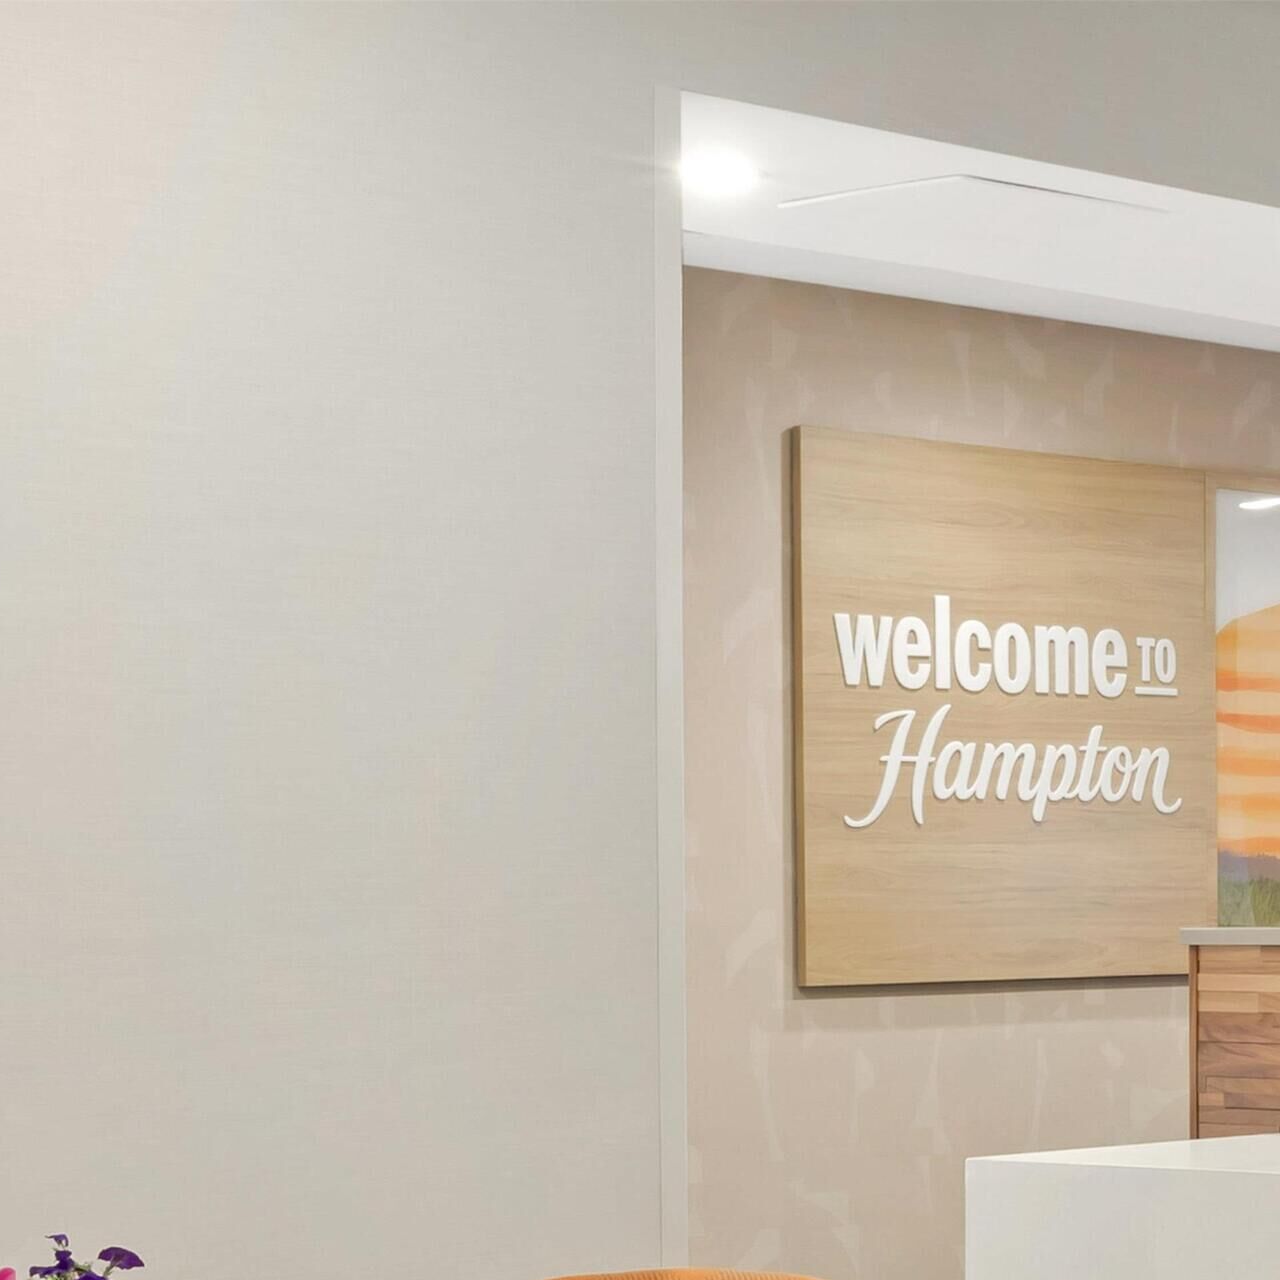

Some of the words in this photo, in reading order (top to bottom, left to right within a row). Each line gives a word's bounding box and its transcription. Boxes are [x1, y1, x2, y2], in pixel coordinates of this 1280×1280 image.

[833, 595, 1128, 698] welcome
[1135, 637, 1177, 684] TO
[843, 704, 1182, 828] Hampton
